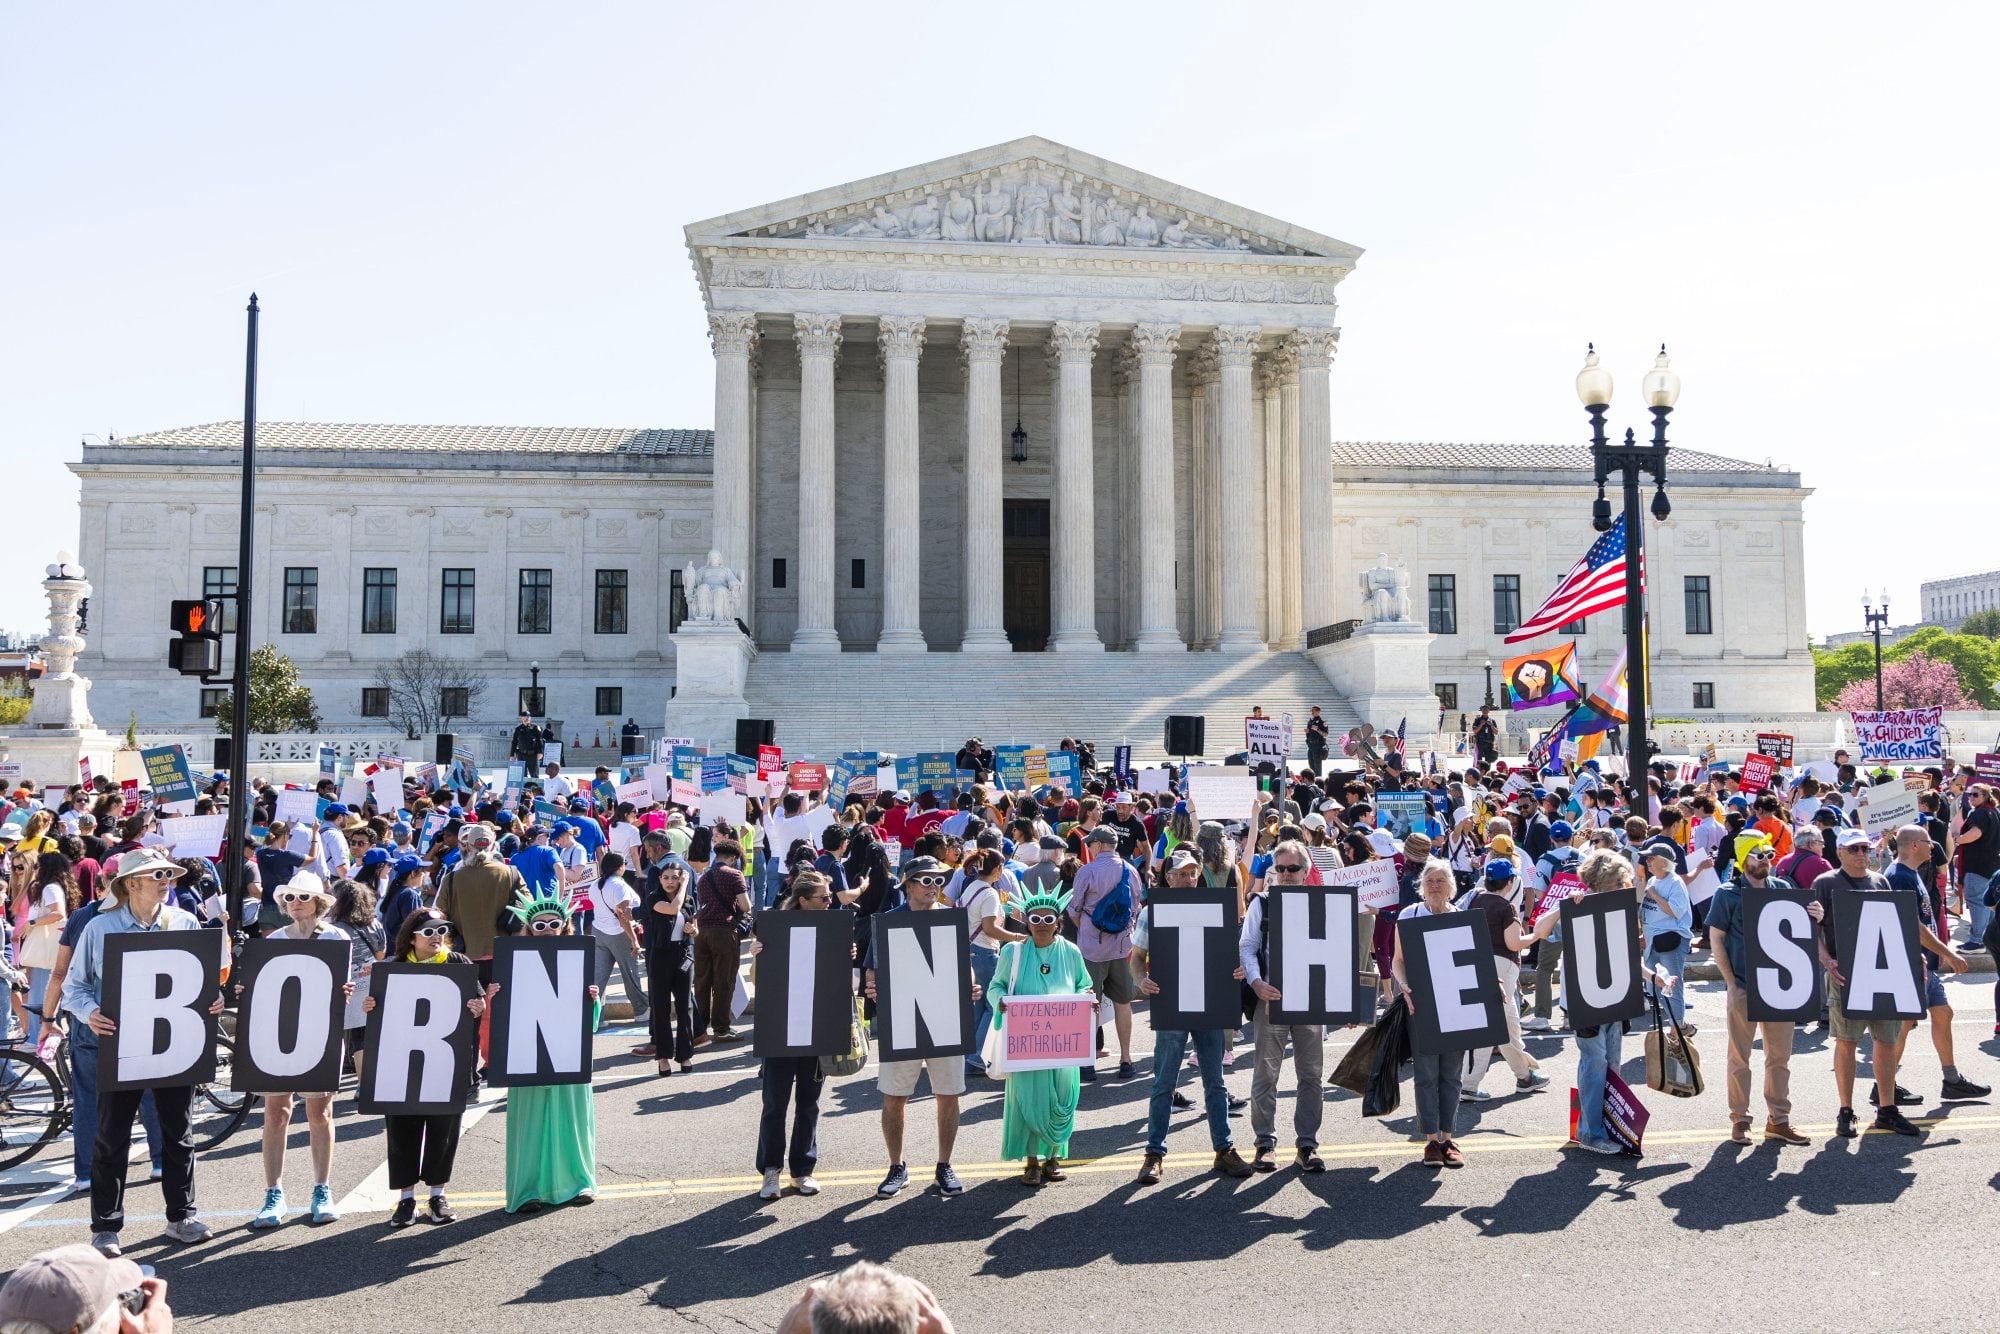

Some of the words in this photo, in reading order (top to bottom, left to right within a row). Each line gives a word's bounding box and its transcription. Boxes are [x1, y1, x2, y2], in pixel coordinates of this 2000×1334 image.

[1923, 725, 1938, 739] of
[1250, 742, 1282, 755] ALL
[1858, 739, 1942, 760] IMMIGRANTS
[760, 753, 779, 763] BIRTH
[760, 761, 779, 771] RIGHT
[1745, 761, 1771, 774] BIRTH
[1743, 769, 1770, 783] RIGHT
[1870, 811, 1882, 819] It's
[1881, 805, 1905, 816] literally
[1333, 869, 1368, 887] NACIDO
[1011, 1003, 1078, 1018] CITIZENSHIP
[1031, 1021, 1039, 1031] IS
[1044, 1020, 1053, 1031] A
[1008, 1032, 1082, 1054] BIRTHRIGHT
